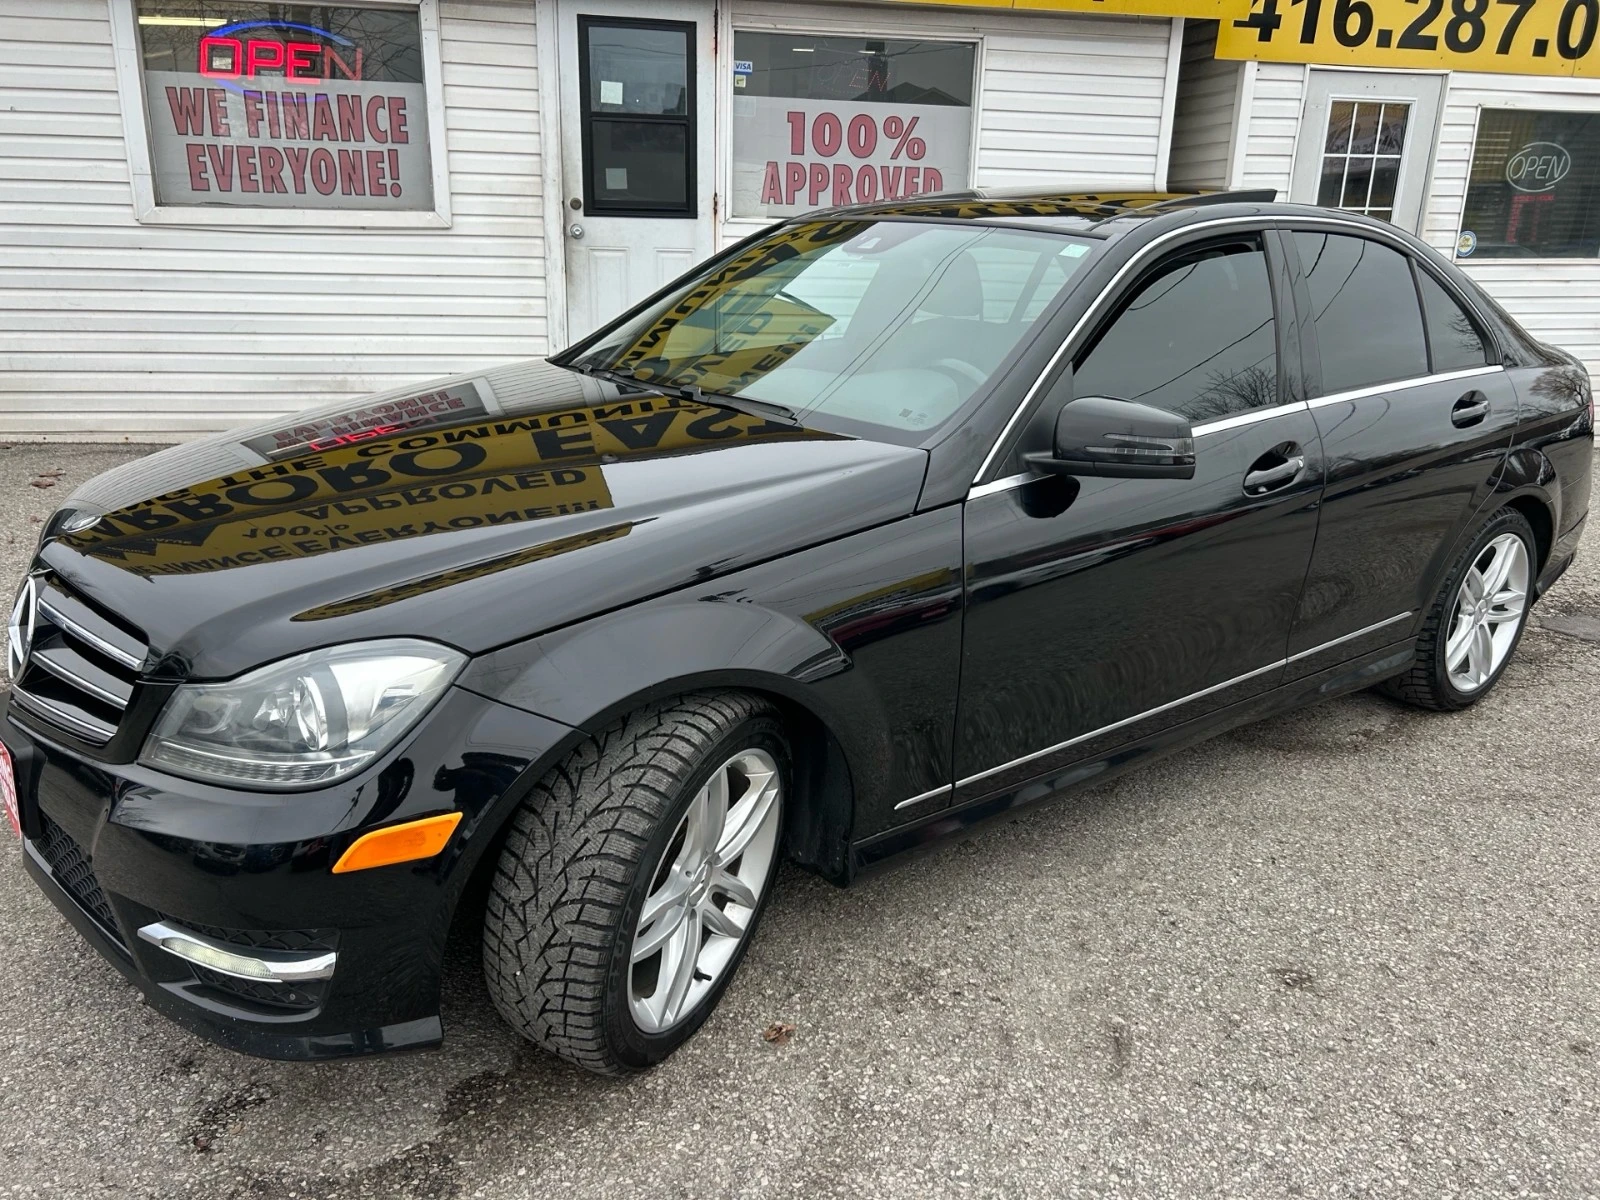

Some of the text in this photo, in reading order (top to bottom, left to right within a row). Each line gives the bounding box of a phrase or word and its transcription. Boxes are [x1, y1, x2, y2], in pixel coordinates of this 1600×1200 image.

[200, 37, 363, 84] OPEN
[735, 62, 752, 71] VISA
[165, 86, 409, 145] WE FINANCE
[787, 111, 926, 161] 100%
[185, 143, 403, 198] EVERYONE!
[761, 161, 943, 207] APPROVED
[1509, 155, 1566, 179] OPEN
